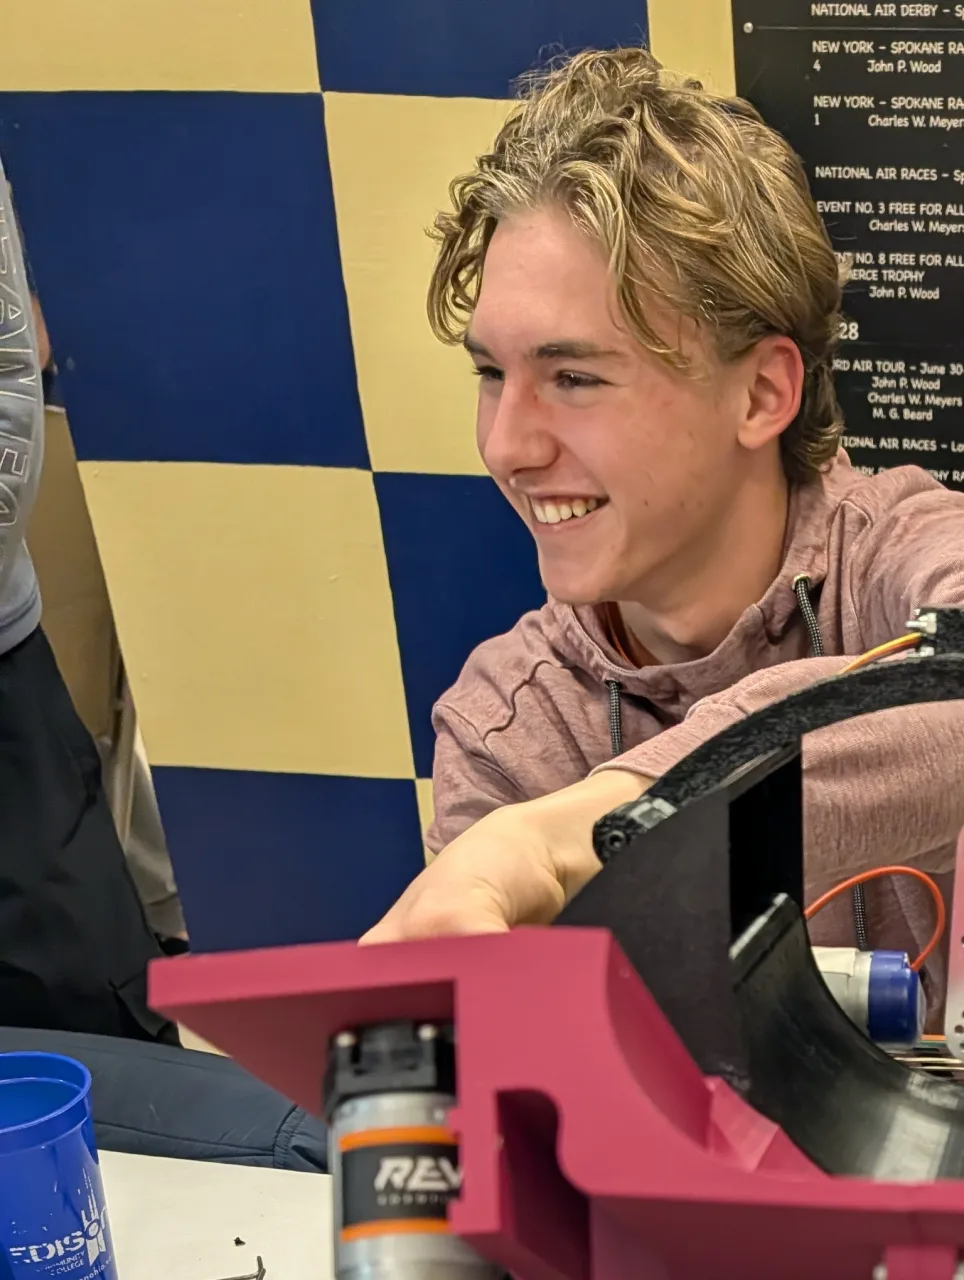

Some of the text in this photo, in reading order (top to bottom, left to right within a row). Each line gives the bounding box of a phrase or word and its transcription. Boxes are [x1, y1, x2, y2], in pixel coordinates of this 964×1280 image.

[812, 4, 871, 16] NATIONAL
[875, 4, 896, 16] AIR
[900, 4, 937, 16] DERBY
[813, 41, 840, 53] NEW
[843, 41, 874, 53] YORK
[891, 42, 944, 54] SPOKANE
[814, 60, 821, 71] 4
[868, 60, 894, 72] John
[897, 60, 907, 72] P.
[910, 60, 941, 73] Wood
[814, 96, 841, 107] NEW
[844, 96, 874, 108] YORK
[891, 97, 943, 109] SPOKANE
[815, 114, 819, 126] 1
[868, 115, 909, 127] Charles
[912, 115, 926, 127] W.
[816, 167, 873, 179] NATIONAL
[876, 167, 896, 179] AIR
[901, 168, 937, 180] RACES
[817, 201, 851, 212] EVENT
[855, 202, 874, 213] NO.
[879, 202, 885, 213] 3
[889, 203, 915, 214] FREE
[920, 204, 942, 215] FOR
[869, 219, 909, 230] Charles
[911, 221, 925, 231] W.
[872, 377, 896, 388] John
[911, 379, 940, 390] Wood
[374, 1156, 464, 1191] REV
